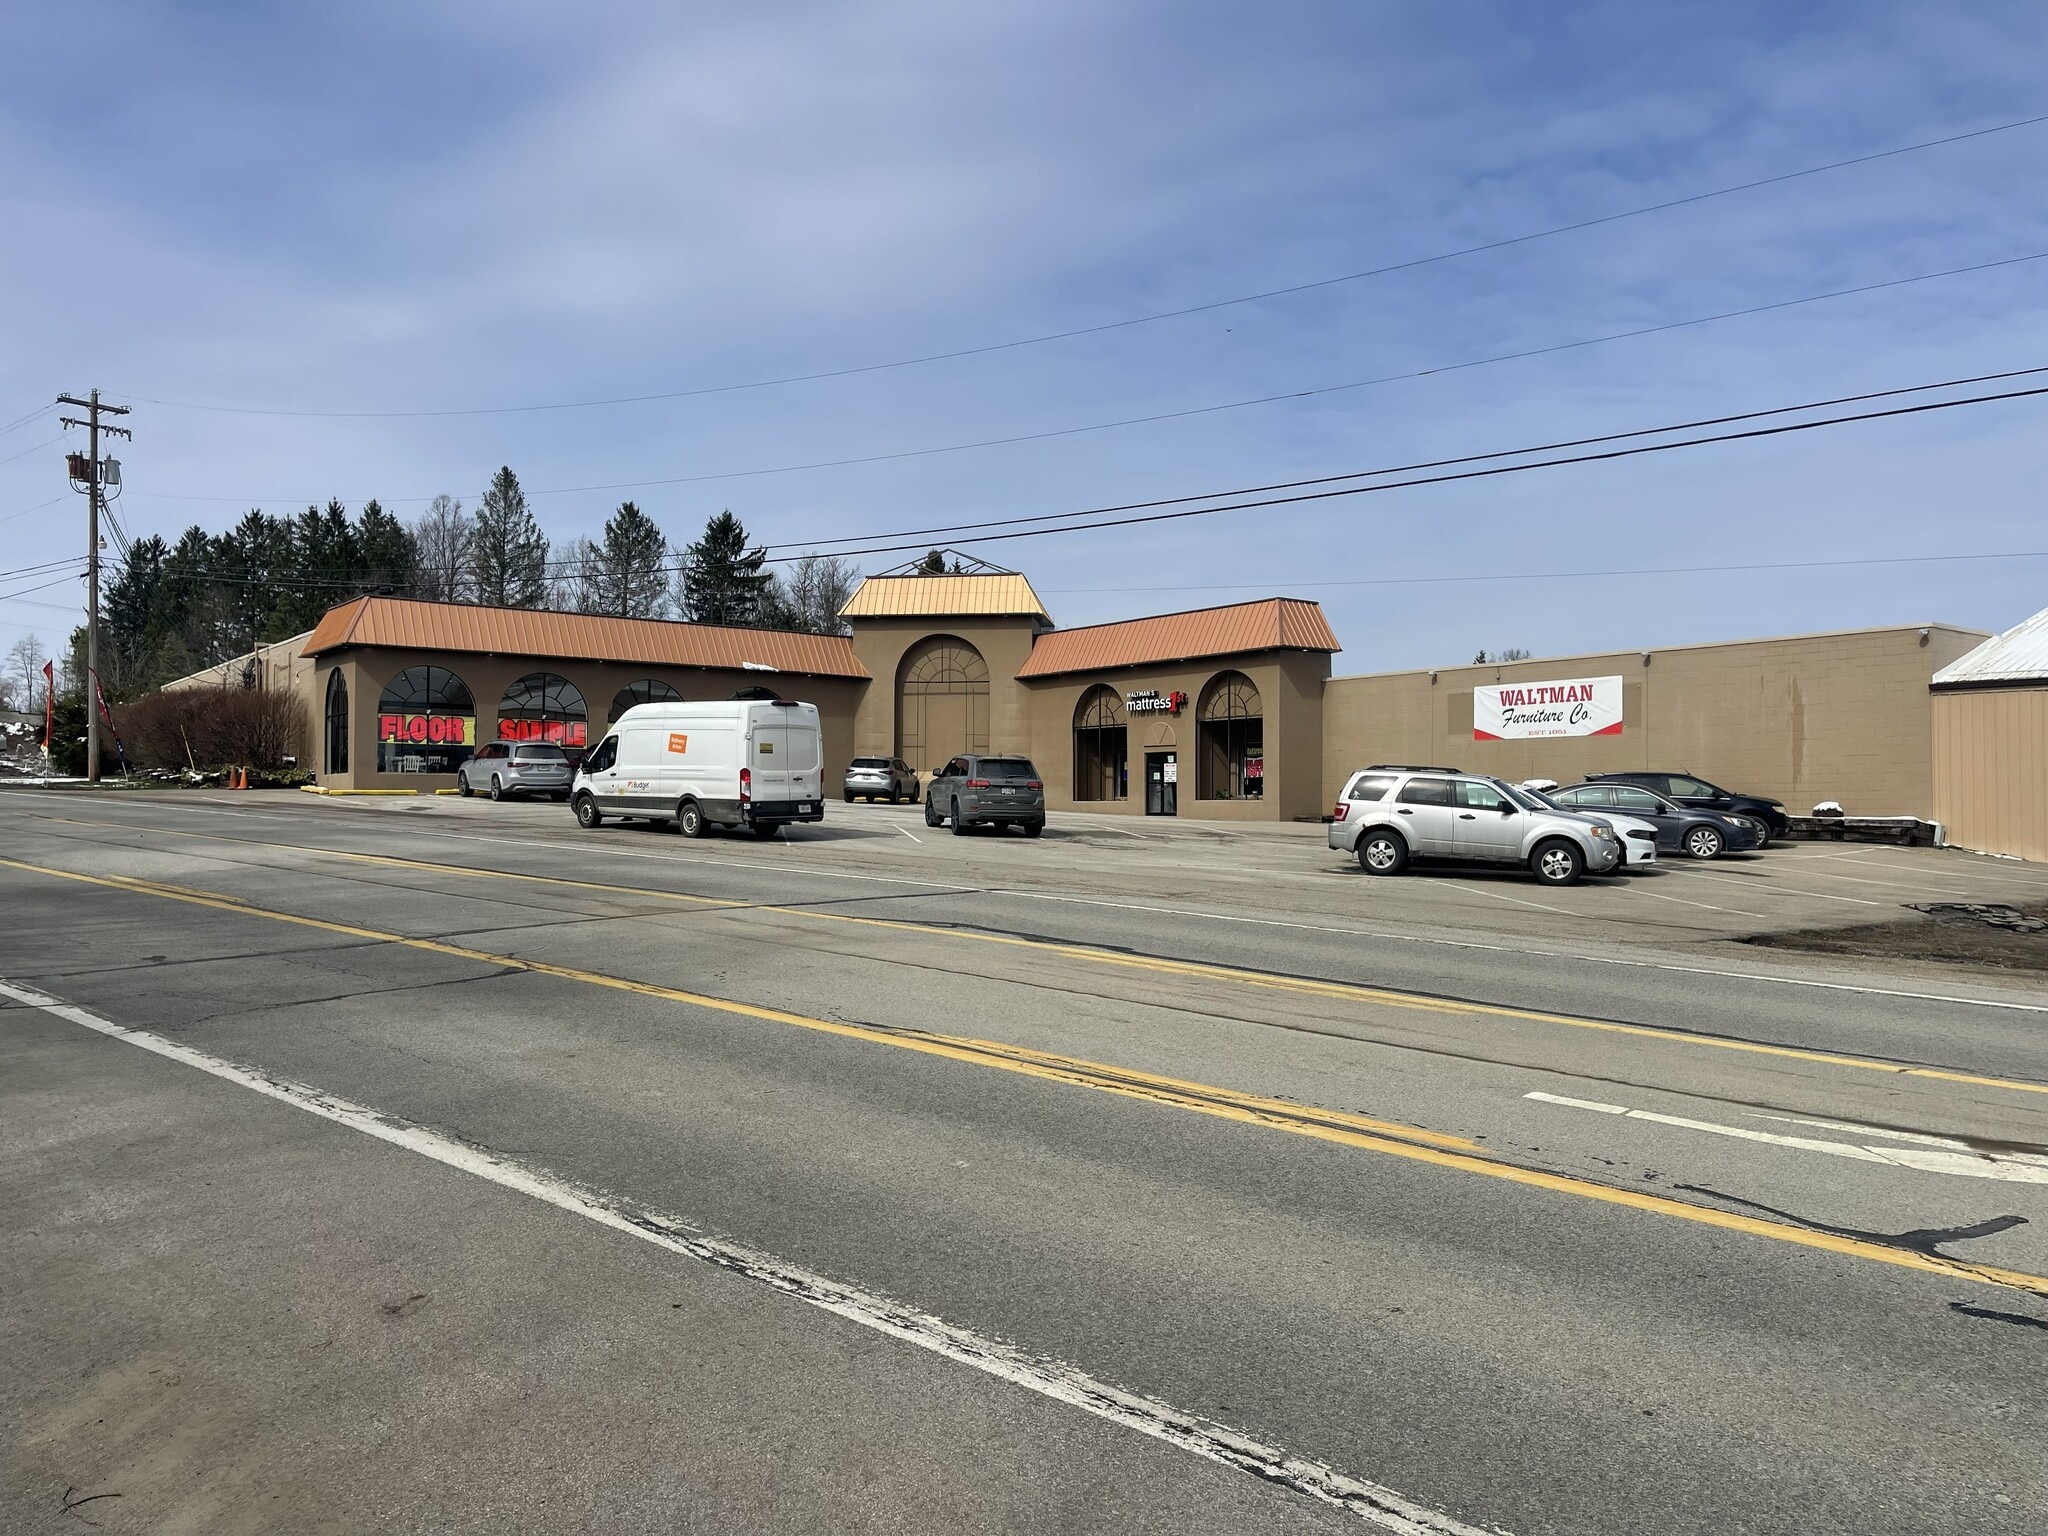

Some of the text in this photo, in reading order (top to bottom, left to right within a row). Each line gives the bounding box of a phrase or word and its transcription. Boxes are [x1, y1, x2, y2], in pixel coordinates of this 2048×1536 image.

[1126, 698, 1171, 711] mattress
[1500, 685, 1593, 706] WALTMAN
[1502, 703, 1592, 729] Furniture Co.
[380, 715, 464, 744] FLOOR
[499, 718, 587, 747] SAMPLE
[633, 781, 650, 791] Budget
